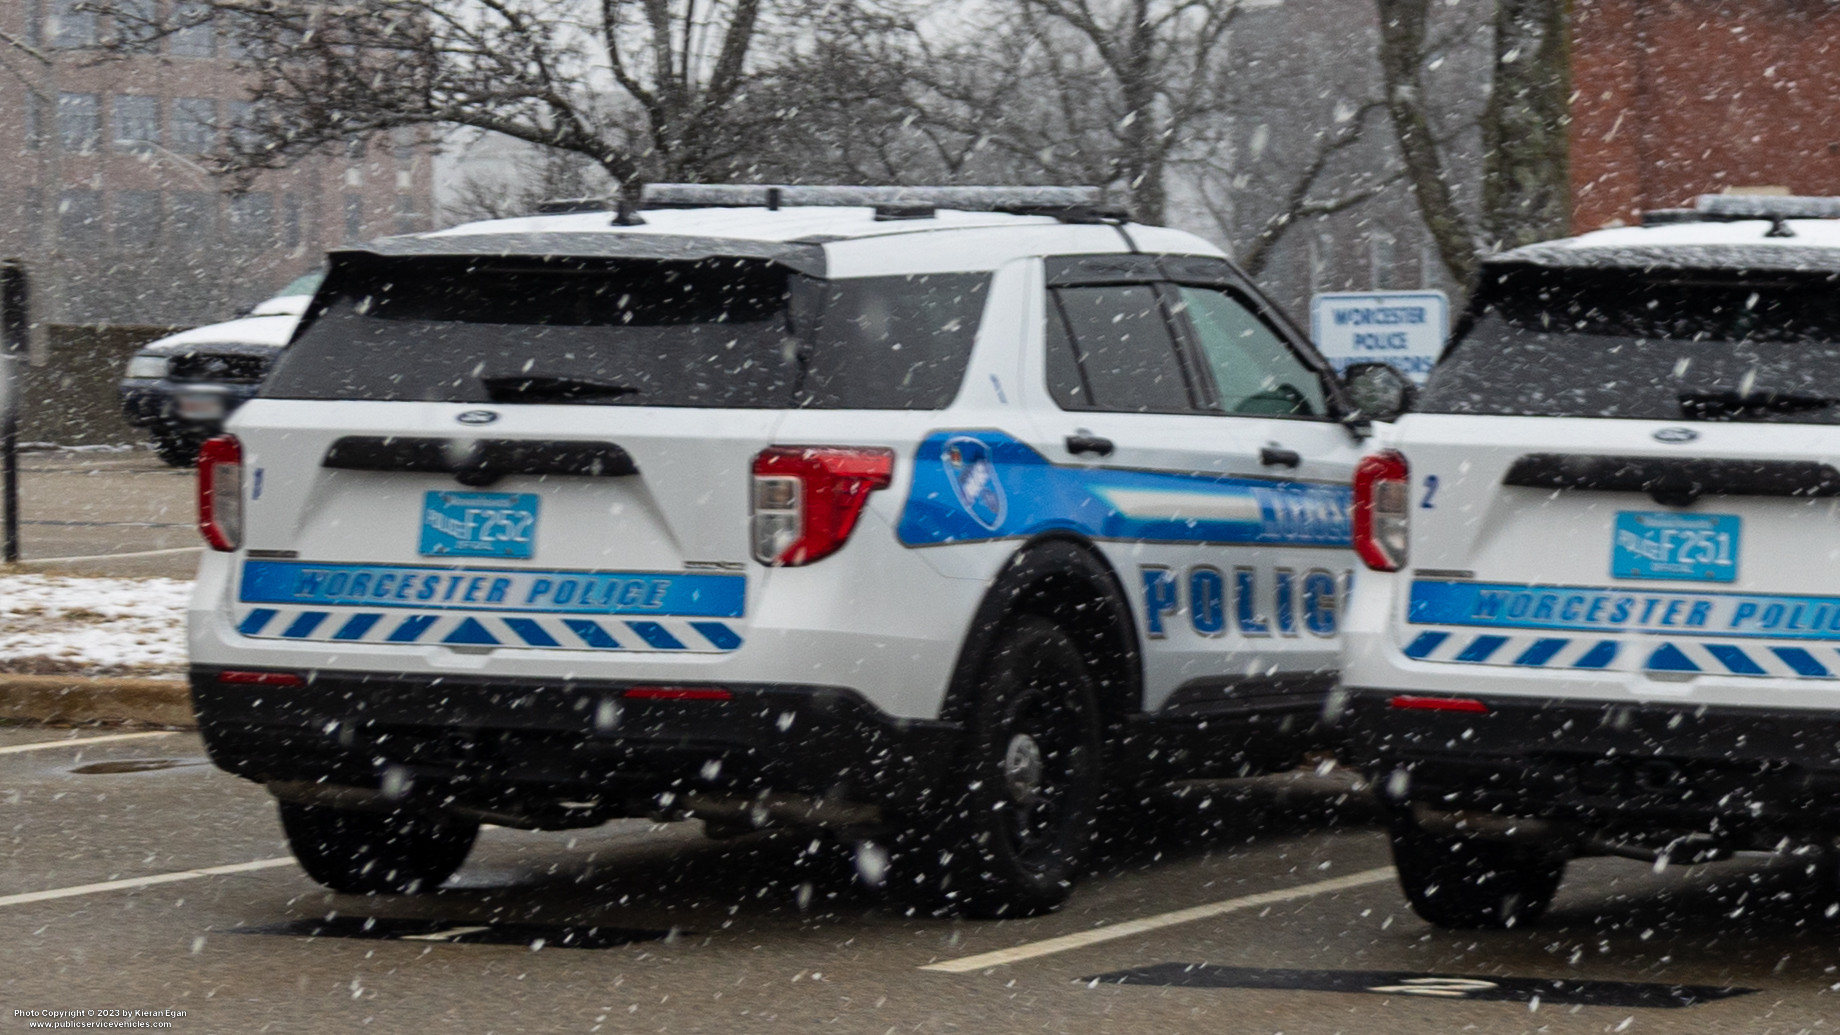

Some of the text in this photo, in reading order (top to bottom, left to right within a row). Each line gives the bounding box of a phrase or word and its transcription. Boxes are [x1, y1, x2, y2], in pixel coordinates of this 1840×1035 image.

[1333, 306, 1426, 325] WORCESTER
[1353, 331, 1407, 350] POLICE
[1420, 474, 1440, 509] 2
[464, 508, 534, 542] F252
[1660, 529, 1733, 566] F251
[294, 568, 673, 609] WORCESTER POLICE
[1471, 588, 1711, 628] WORCESTER
